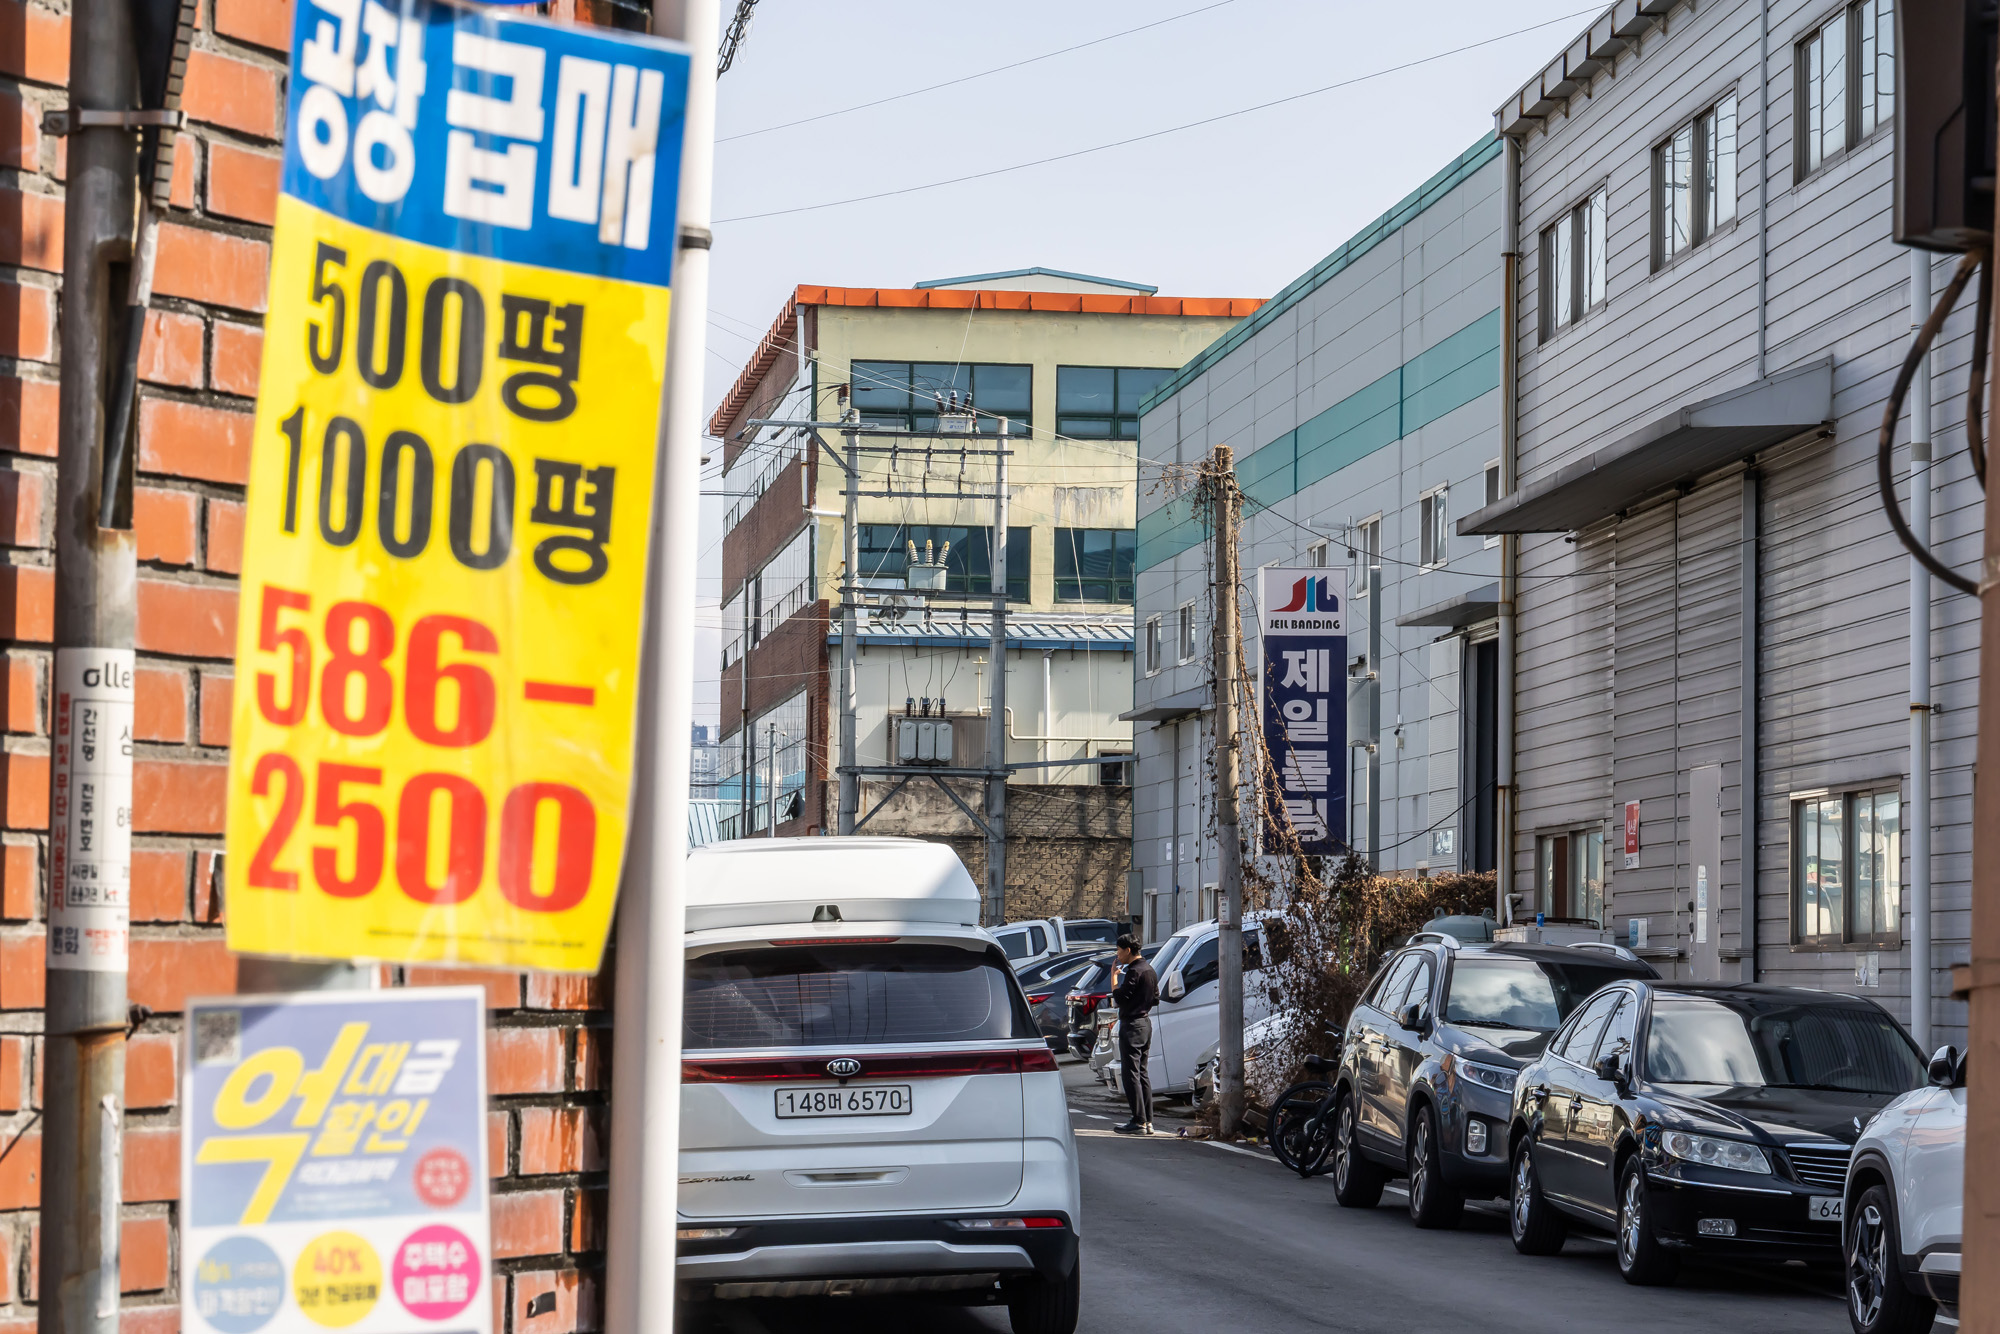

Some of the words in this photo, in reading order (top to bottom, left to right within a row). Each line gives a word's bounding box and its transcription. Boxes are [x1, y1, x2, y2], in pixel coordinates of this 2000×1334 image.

[298, 0, 427, 203] 공장
[443, 31, 665, 251] 급매
[308, 241, 586, 423] 500평
[280, 405, 618, 586] 1000평
[1269, 619, 1289, 630] JEIL
[1291, 619, 1341, 630] BANDING
[82, 662, 132, 689] olle
[256, 584, 596, 749] 586-
[247, 752, 597, 913] 2500
[832, 1062, 856, 1073] KIA
[786, 1092, 842, 1113] 148머
[847, 1090, 902, 1111] 6570
[1820, 1200, 1842, 1218] 64
[312, 1247, 365, 1277] 40%
